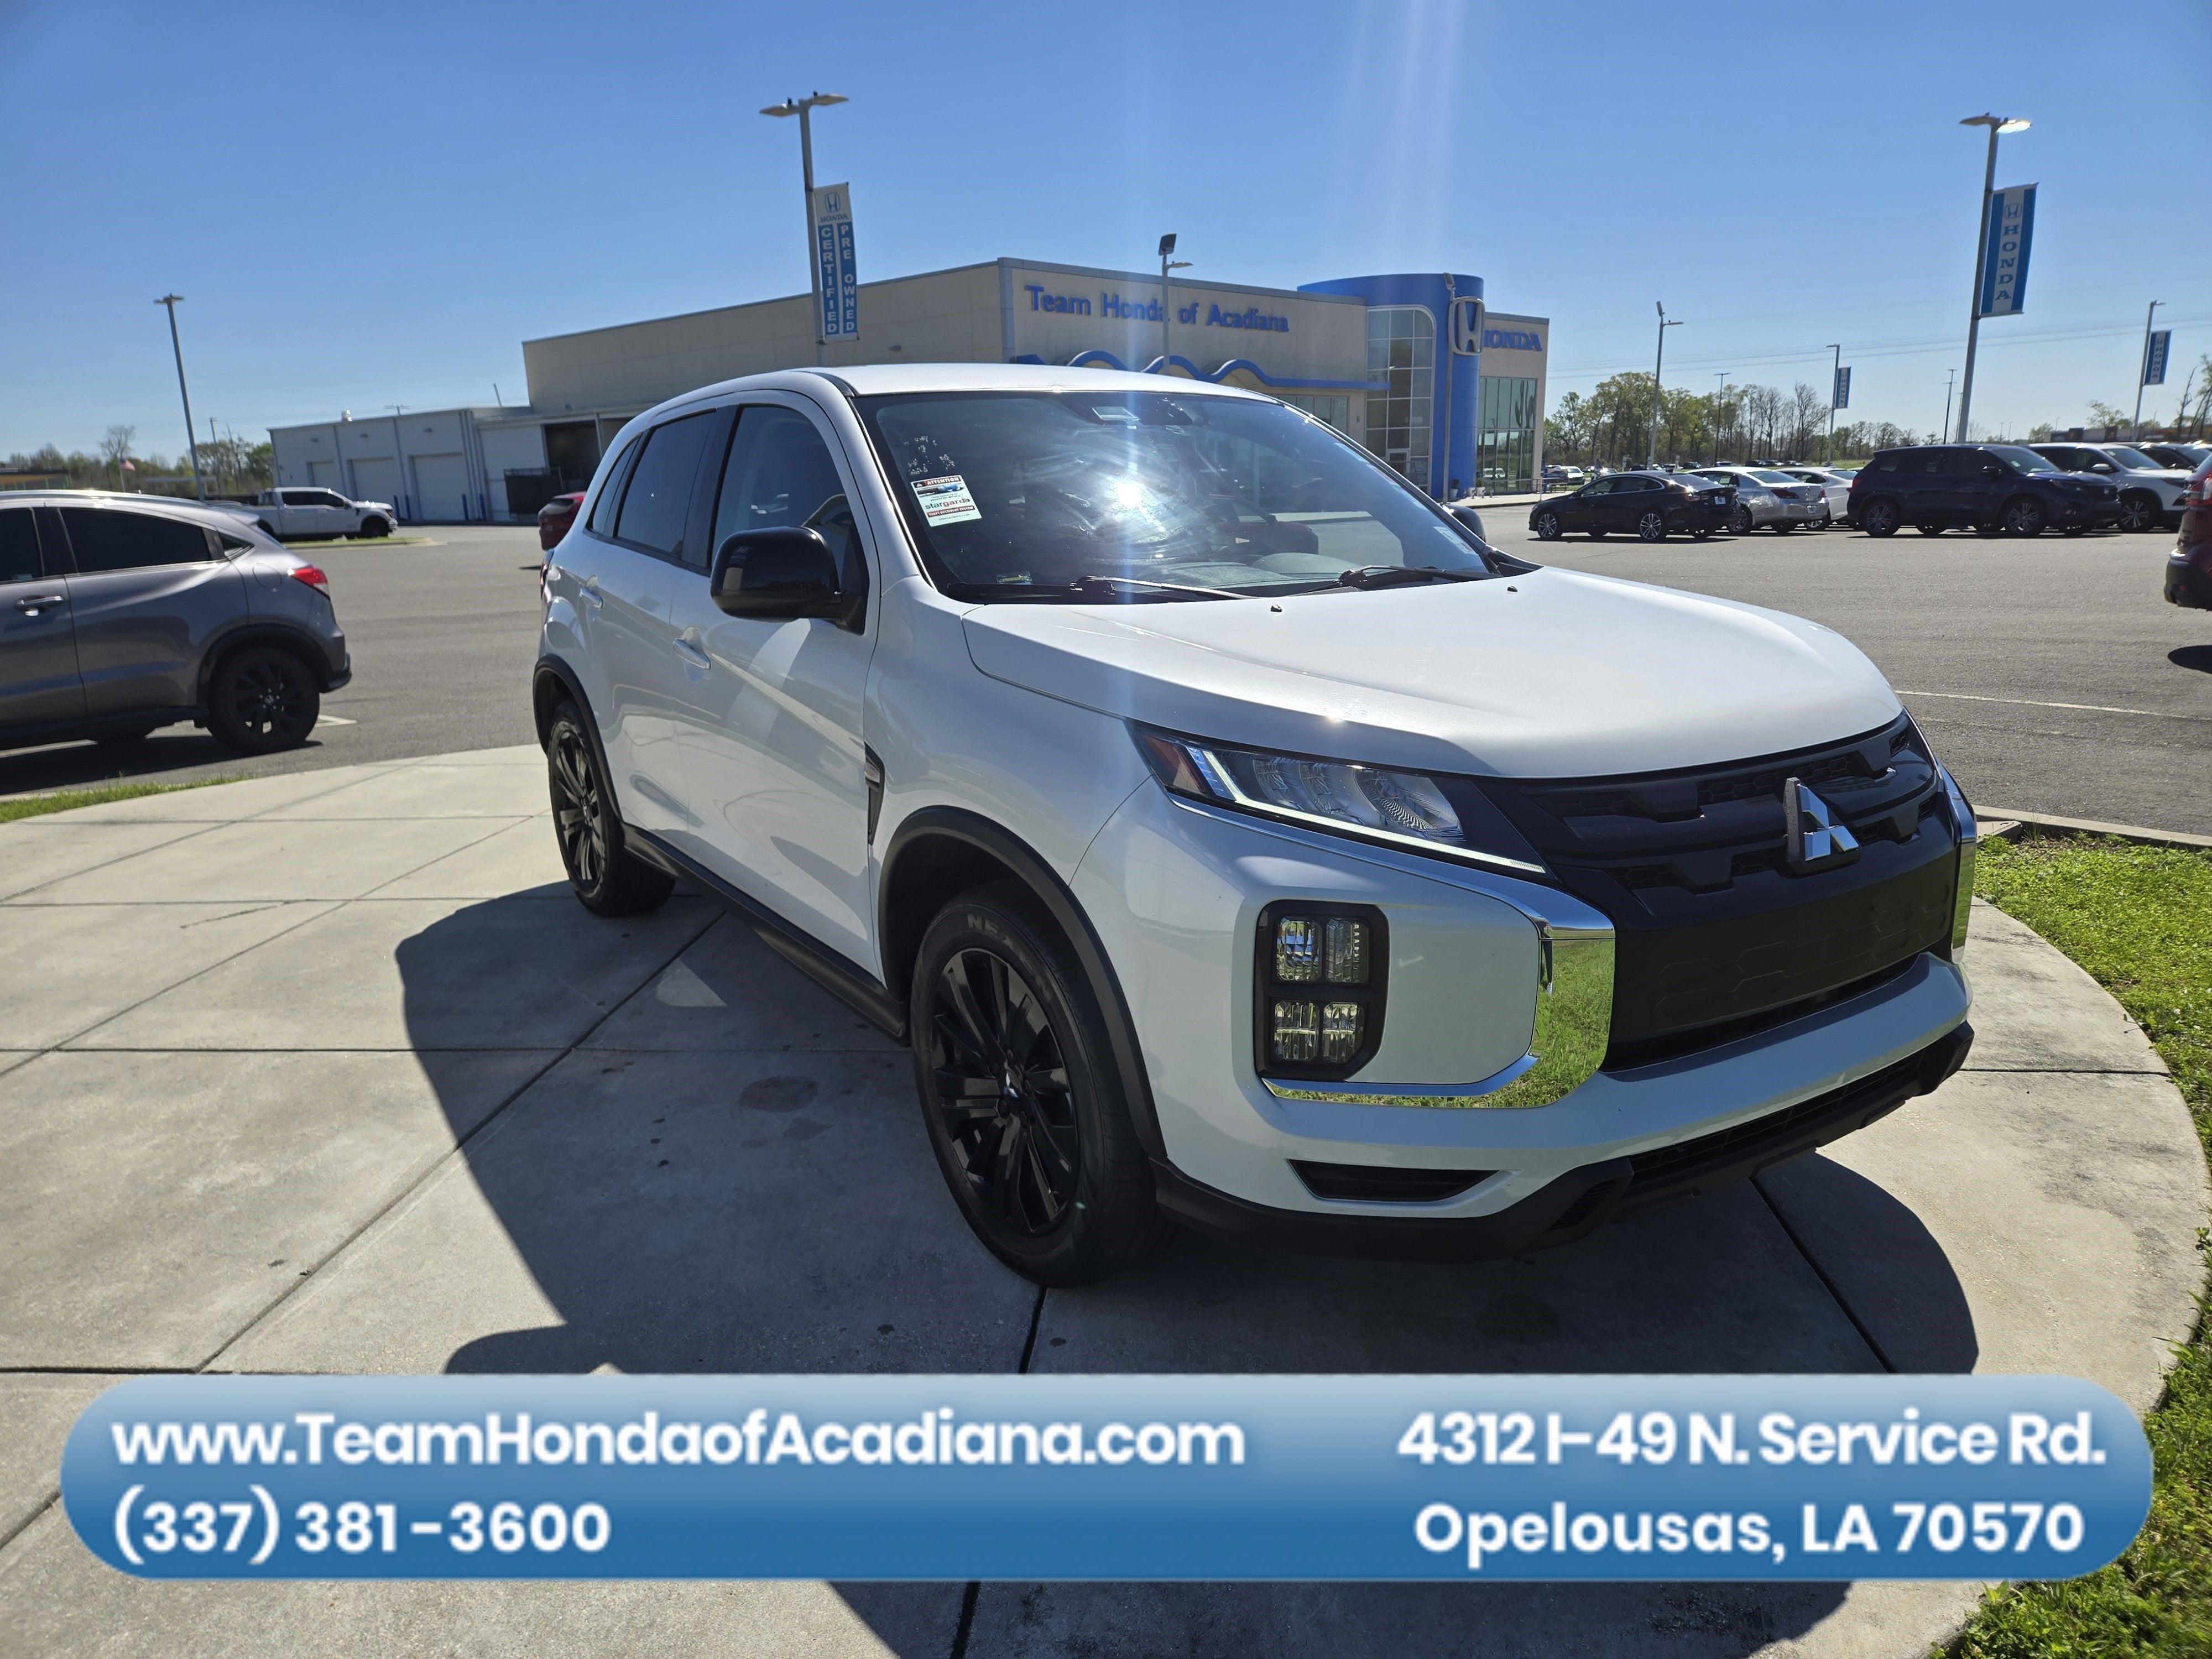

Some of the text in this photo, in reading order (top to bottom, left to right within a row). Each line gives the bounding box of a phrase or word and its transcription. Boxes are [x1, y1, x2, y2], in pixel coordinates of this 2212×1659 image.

[820, 213, 848, 222] HONDA
[821, 227, 838, 333] CERTIFIED
[841, 225, 855, 331] PRE OWNED
[1994, 225, 2020, 301] HONDA
[1025, 284, 1092, 315] Team
[1178, 302, 1199, 325] of
[1206, 304, 1290, 332] Acadiana
[2152, 347, 2162, 378] HONDA
[927, 477, 959, 486] ATTENTION
